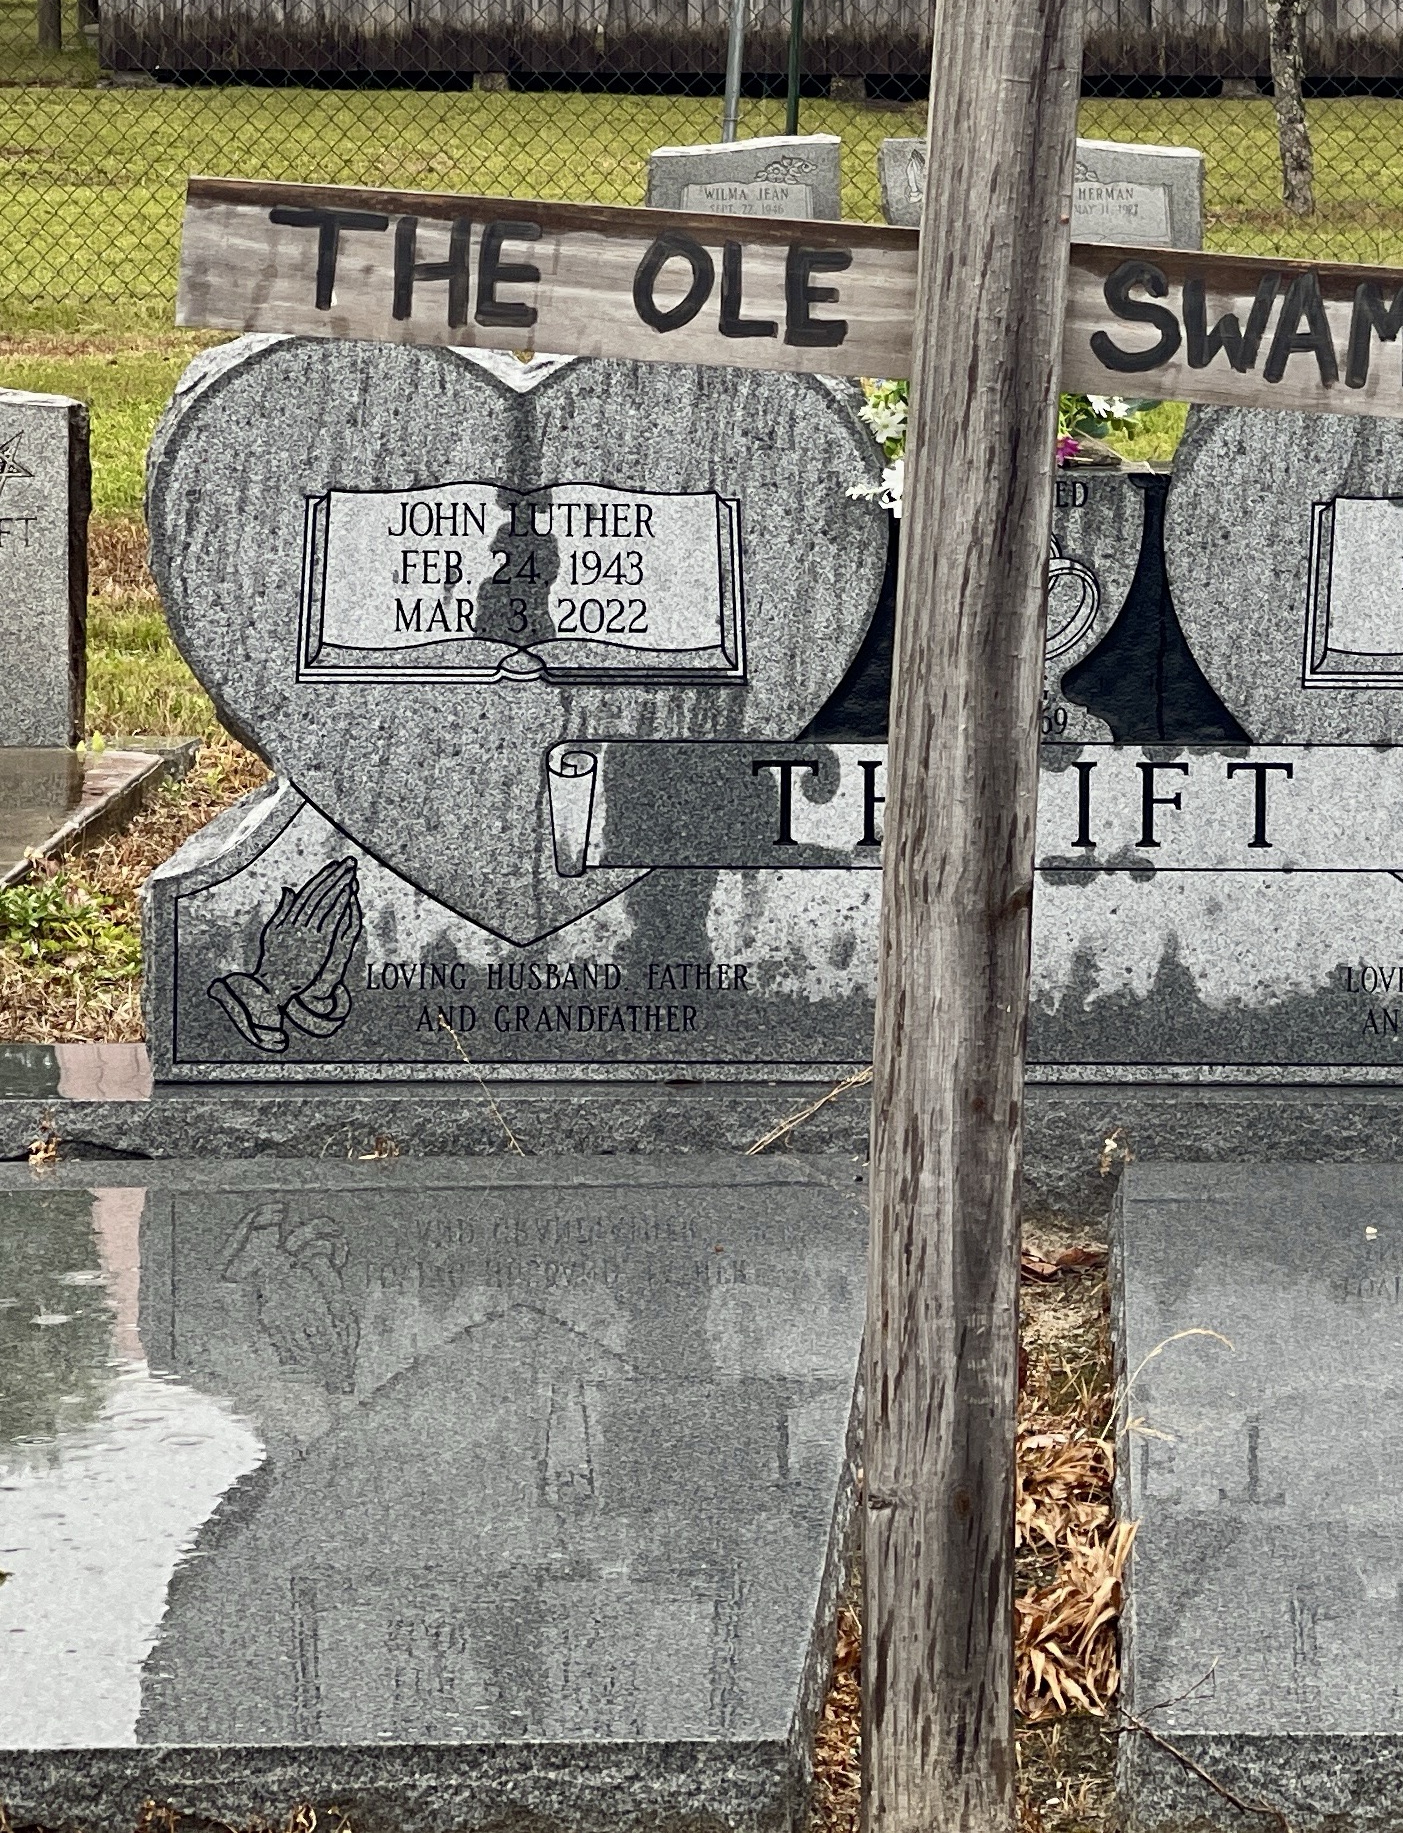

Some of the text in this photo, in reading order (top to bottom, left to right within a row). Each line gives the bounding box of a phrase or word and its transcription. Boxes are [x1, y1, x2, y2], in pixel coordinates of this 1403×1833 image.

[703, 187, 789, 201] WILMA JEAN
[1078, 187, 1134, 201] HERMAN
[269, 207, 543, 329] THE
[632, 230, 853, 347] OLE
[387, 501, 656, 539] JOHN LUTHER
[400, 550, 645, 588] FEB. 24, 1943
[393, 597, 487, 634] MAR.
[557, 597, 649, 634] 2022
[752, 759, 1294, 849] TIFT
[365, 963, 467, 991] LOVING
[647, 963, 751, 991] FATHER
[415, 1005, 698, 1033] AND GRANDFATHER
